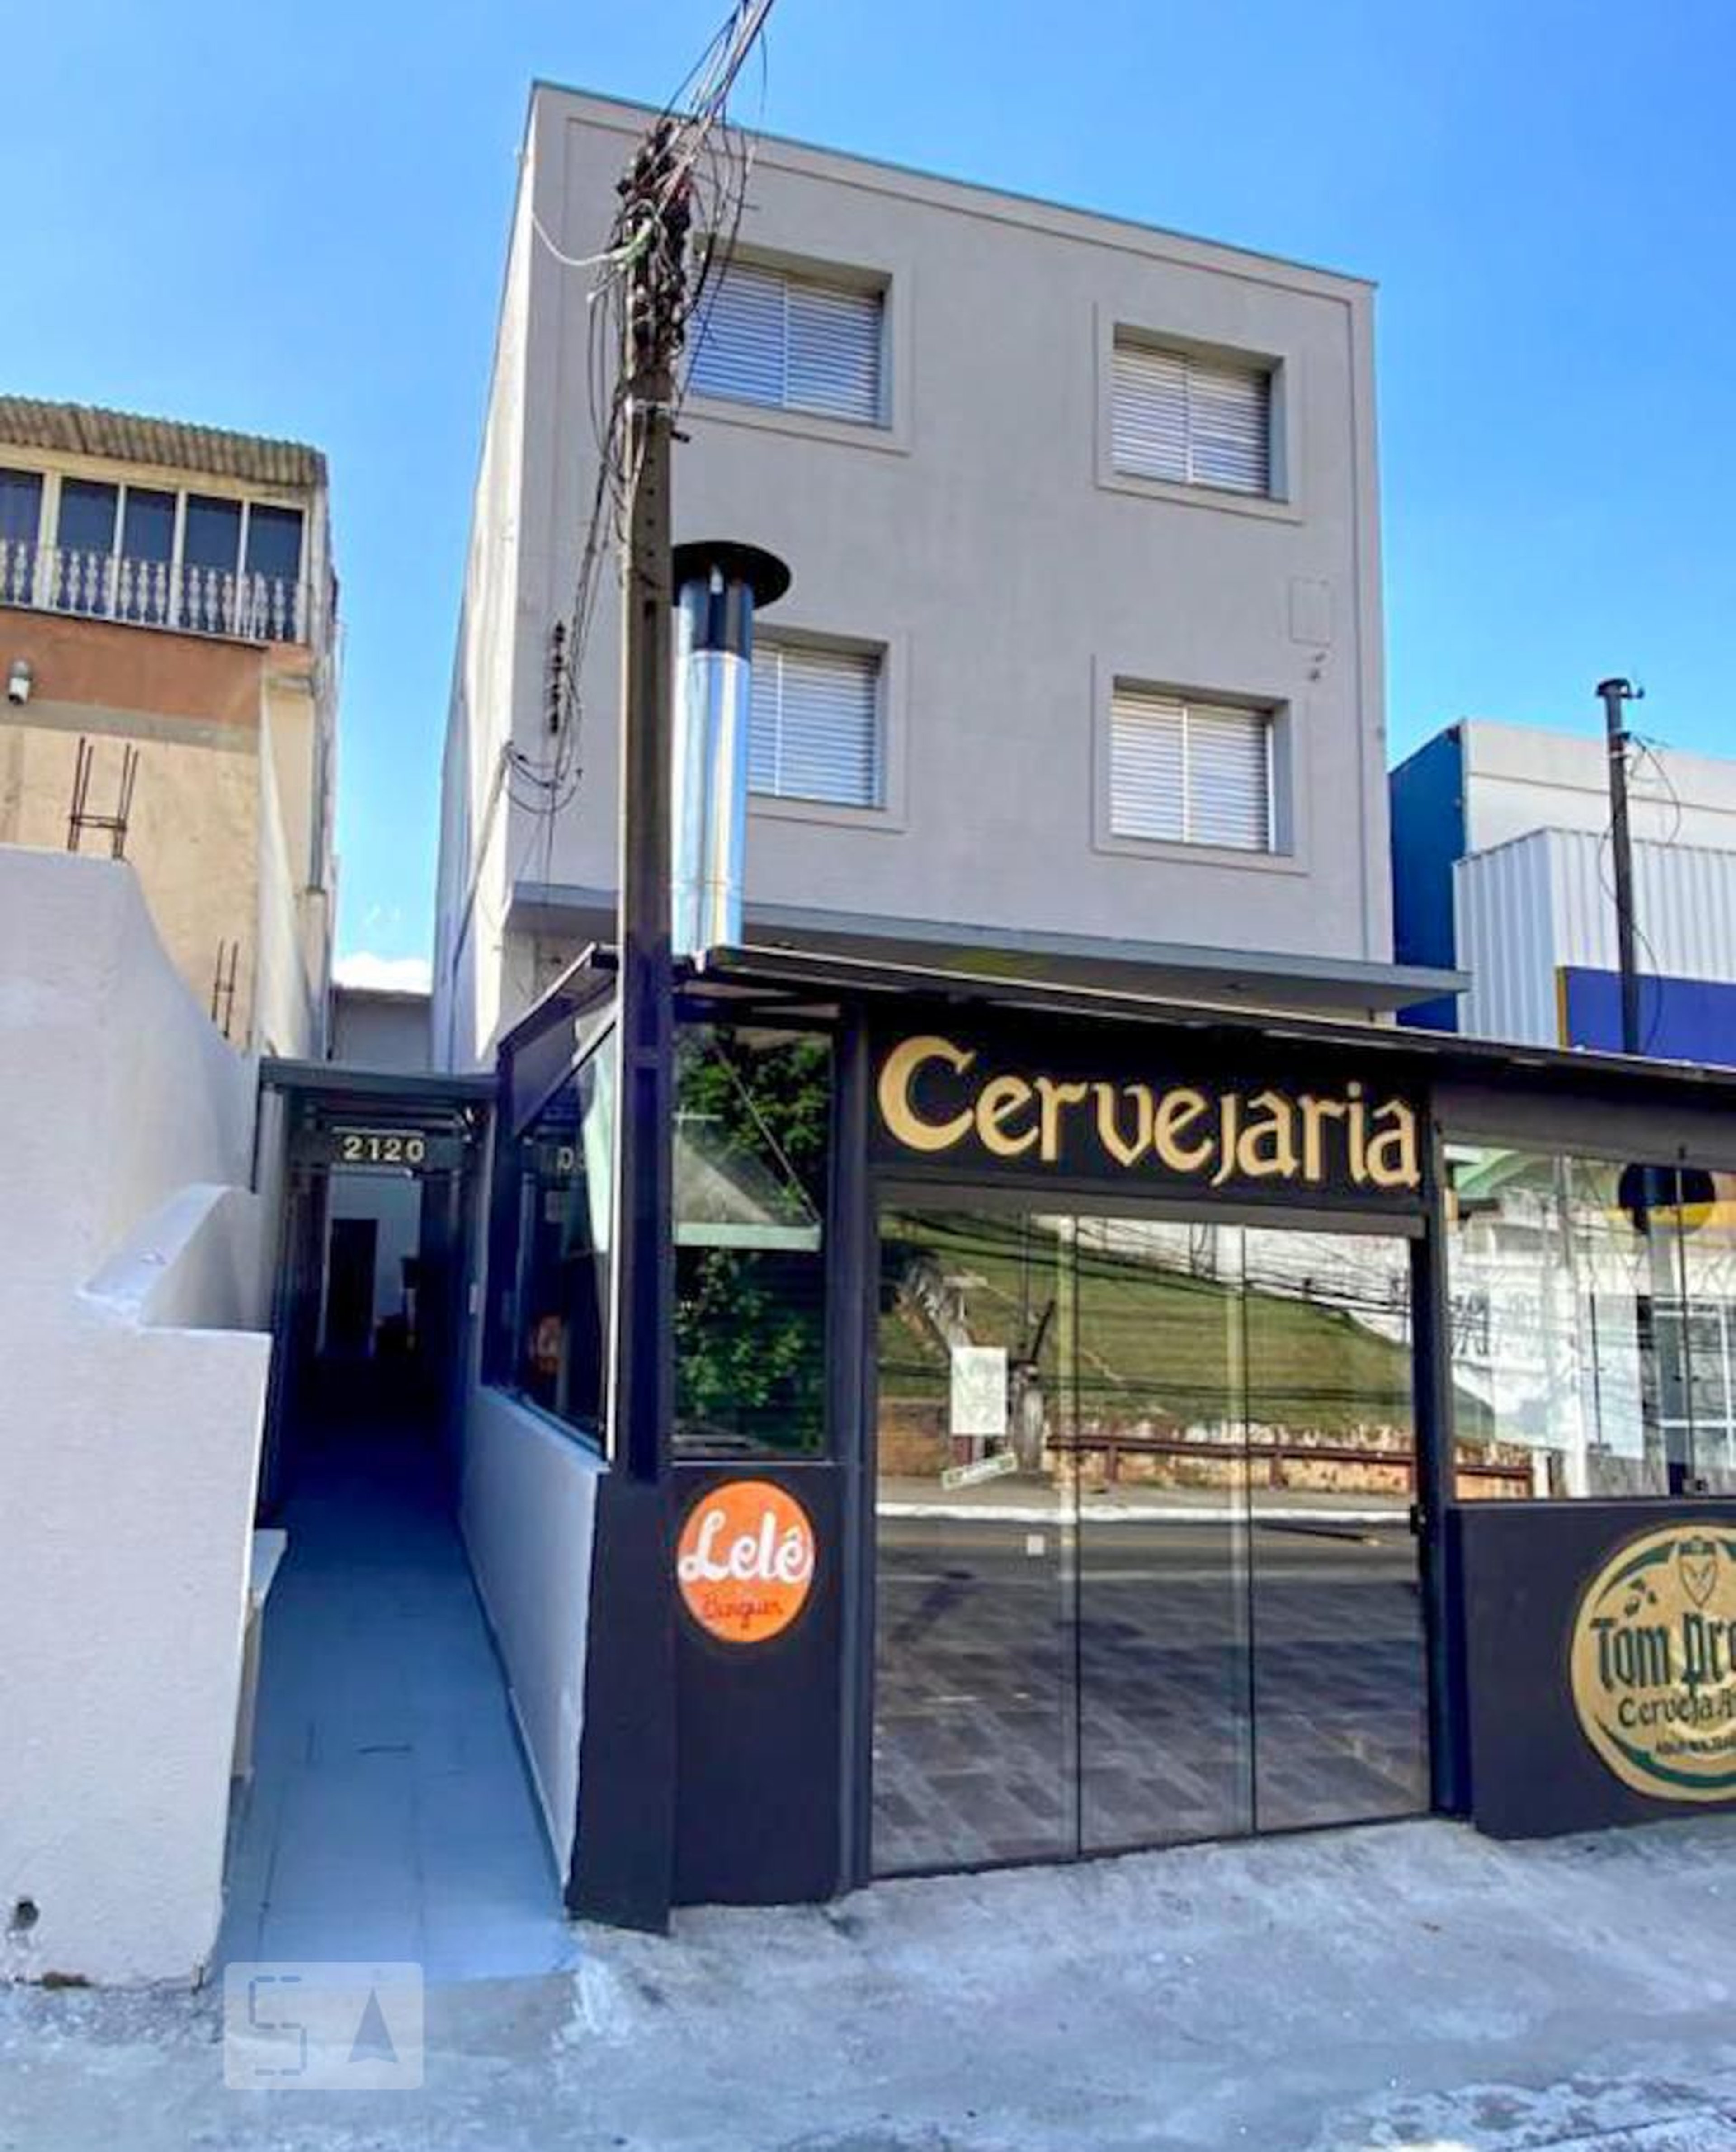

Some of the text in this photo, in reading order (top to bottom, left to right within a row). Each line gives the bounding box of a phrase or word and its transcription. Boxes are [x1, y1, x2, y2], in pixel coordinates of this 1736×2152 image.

[878, 1035, 1421, 1187] Cervejaria
[344, 1135, 425, 1163] 2120
[1590, 1617, 1671, 1692] Tom
